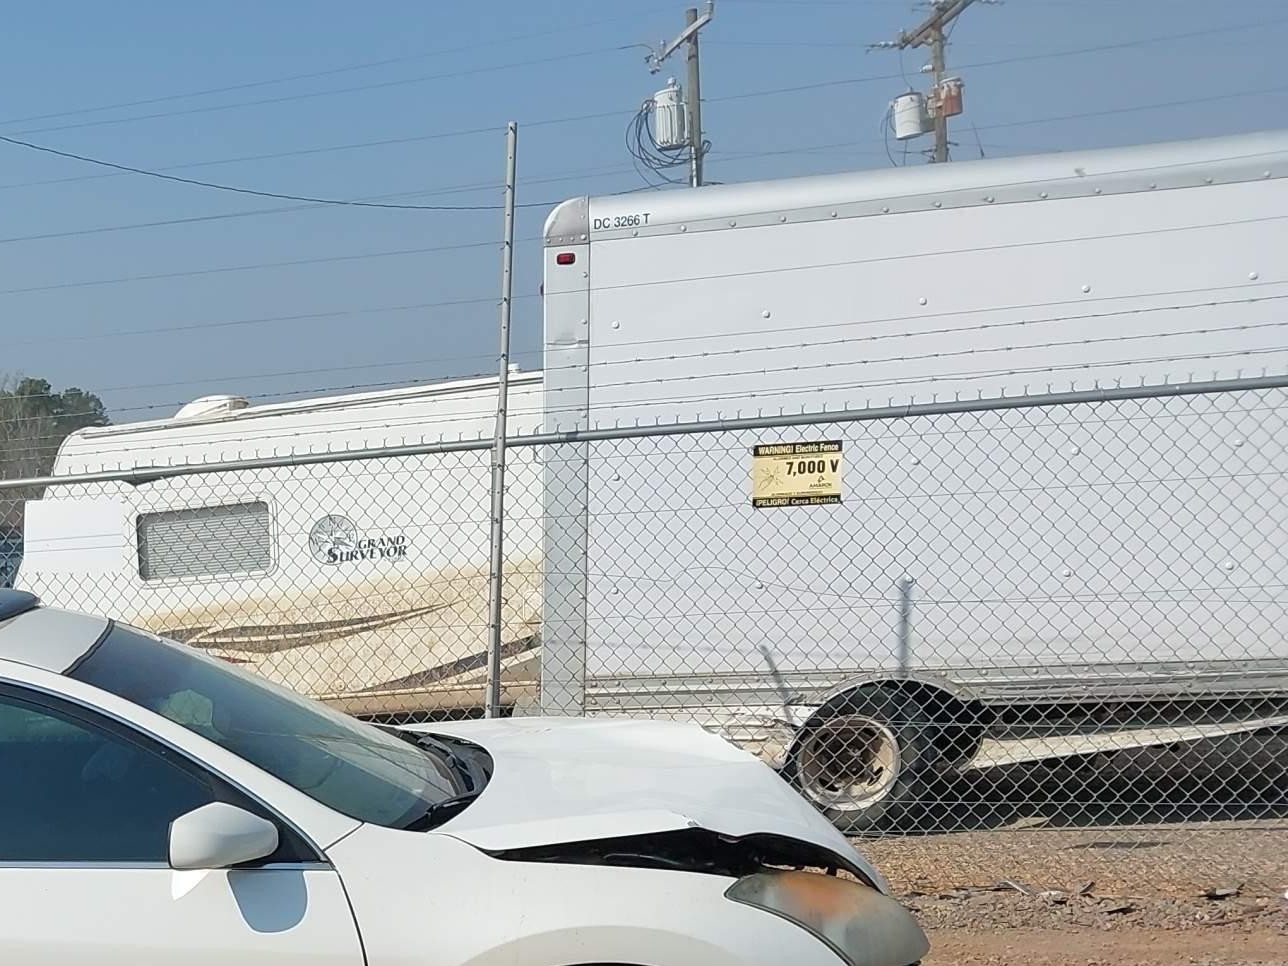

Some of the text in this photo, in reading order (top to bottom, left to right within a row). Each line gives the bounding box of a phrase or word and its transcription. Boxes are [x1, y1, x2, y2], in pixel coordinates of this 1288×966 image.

[593, 212, 651, 230] DC 3266 T
[759, 443, 839, 455] WARNING! Electric Fence
[785, 459, 840, 477] 7,000 V
[358, 536, 405, 549] GRAND
[327, 545, 407, 563] SURVEYOR
